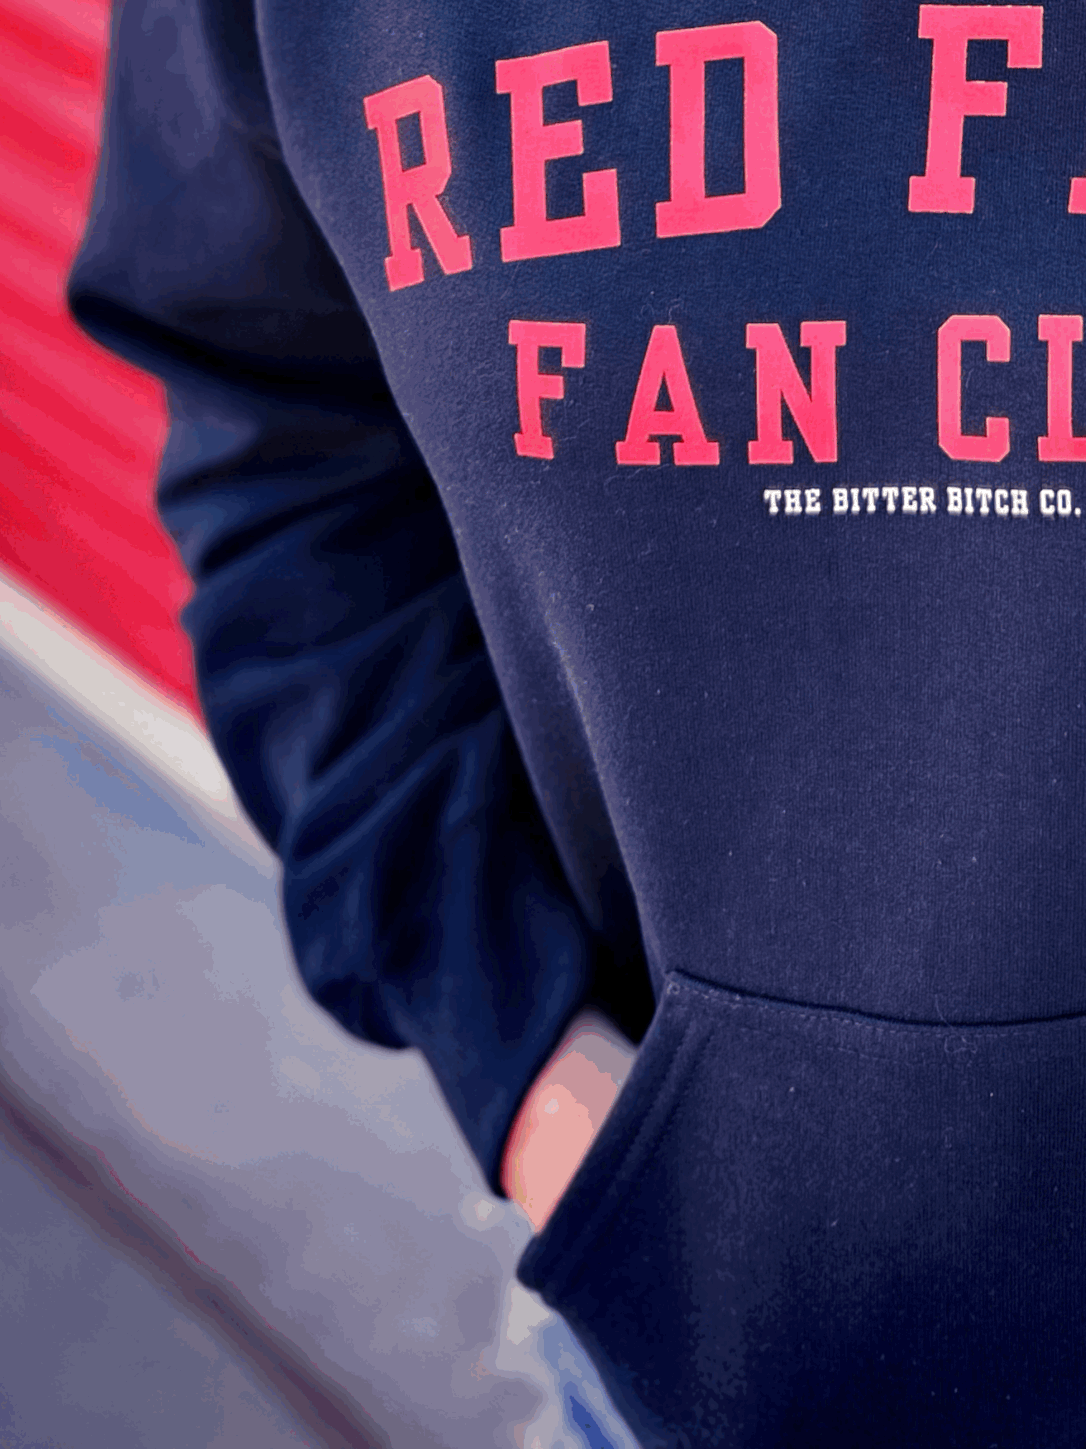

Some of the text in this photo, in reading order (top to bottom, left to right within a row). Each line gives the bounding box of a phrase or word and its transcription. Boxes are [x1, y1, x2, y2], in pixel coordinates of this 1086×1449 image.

[363, 21, 782, 293] RED
[508, 319, 847, 466] FAN
[763, 486, 1081, 517] THE BITTER BITCH CO.
